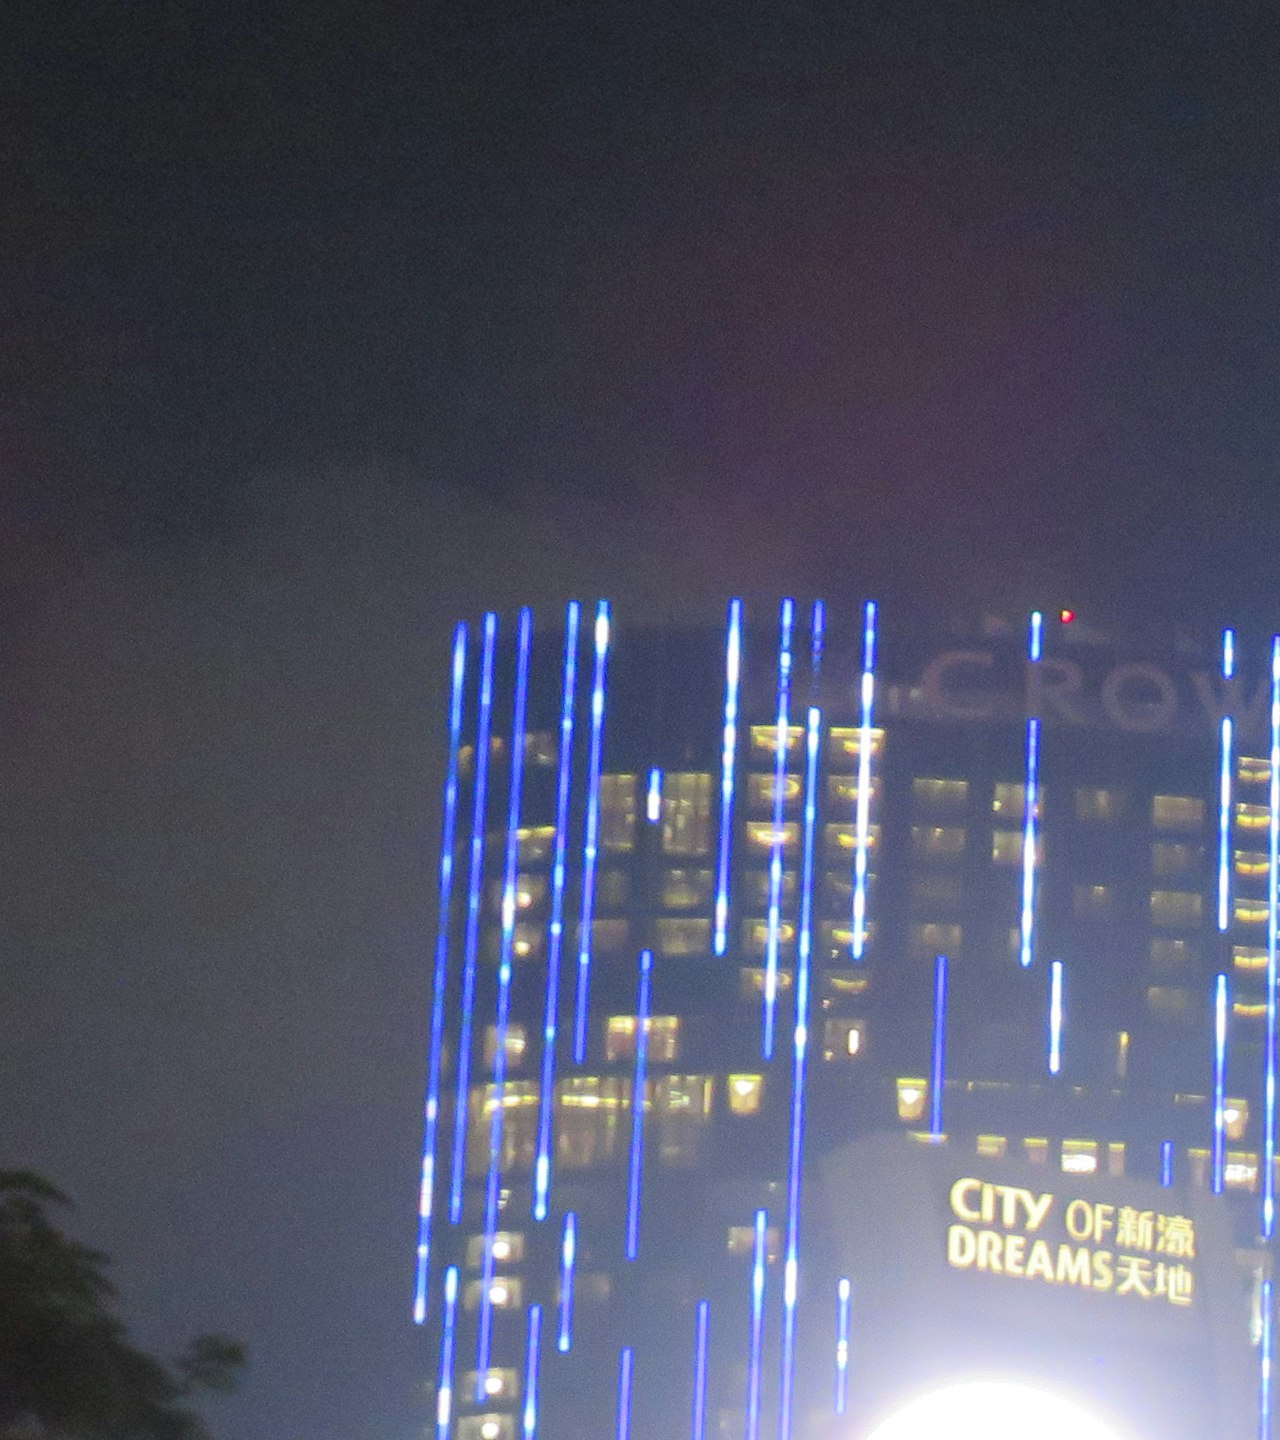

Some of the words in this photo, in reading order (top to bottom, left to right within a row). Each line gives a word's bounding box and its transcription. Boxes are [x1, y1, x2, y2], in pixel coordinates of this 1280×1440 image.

[949, 1177, 1053, 1230] CITY
[1066, 1199, 1114, 1242] OF
[1116, 1205, 1195, 1257] 新濠
[948, 1225, 1113, 1291] DREAMS
[1116, 1255, 1194, 1305] 天地
